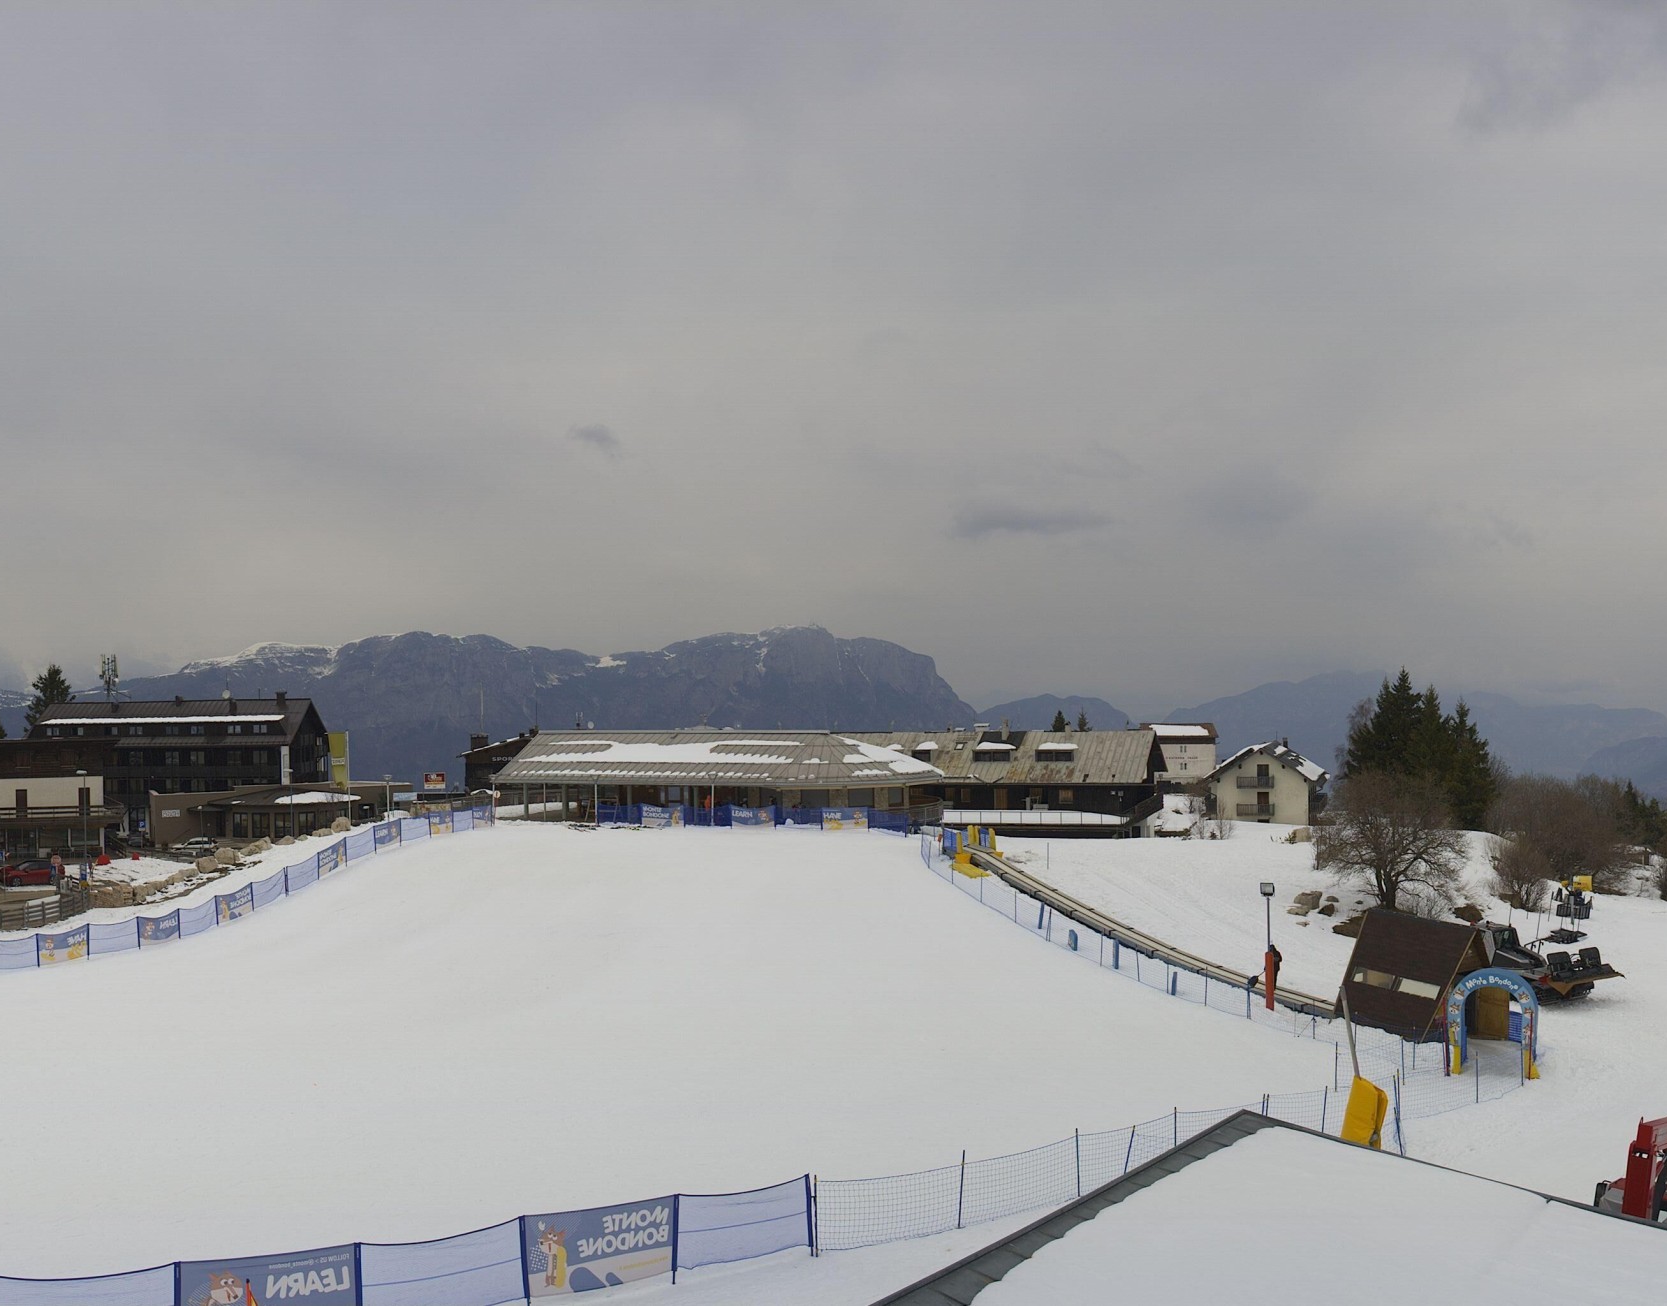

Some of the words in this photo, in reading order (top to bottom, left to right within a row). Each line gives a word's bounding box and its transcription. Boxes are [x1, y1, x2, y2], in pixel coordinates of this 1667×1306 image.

[731, 810, 753, 818] LEARN
[1465, 976, 1488, 990] Monte
[1488, 976, 1519, 990] Bondone
